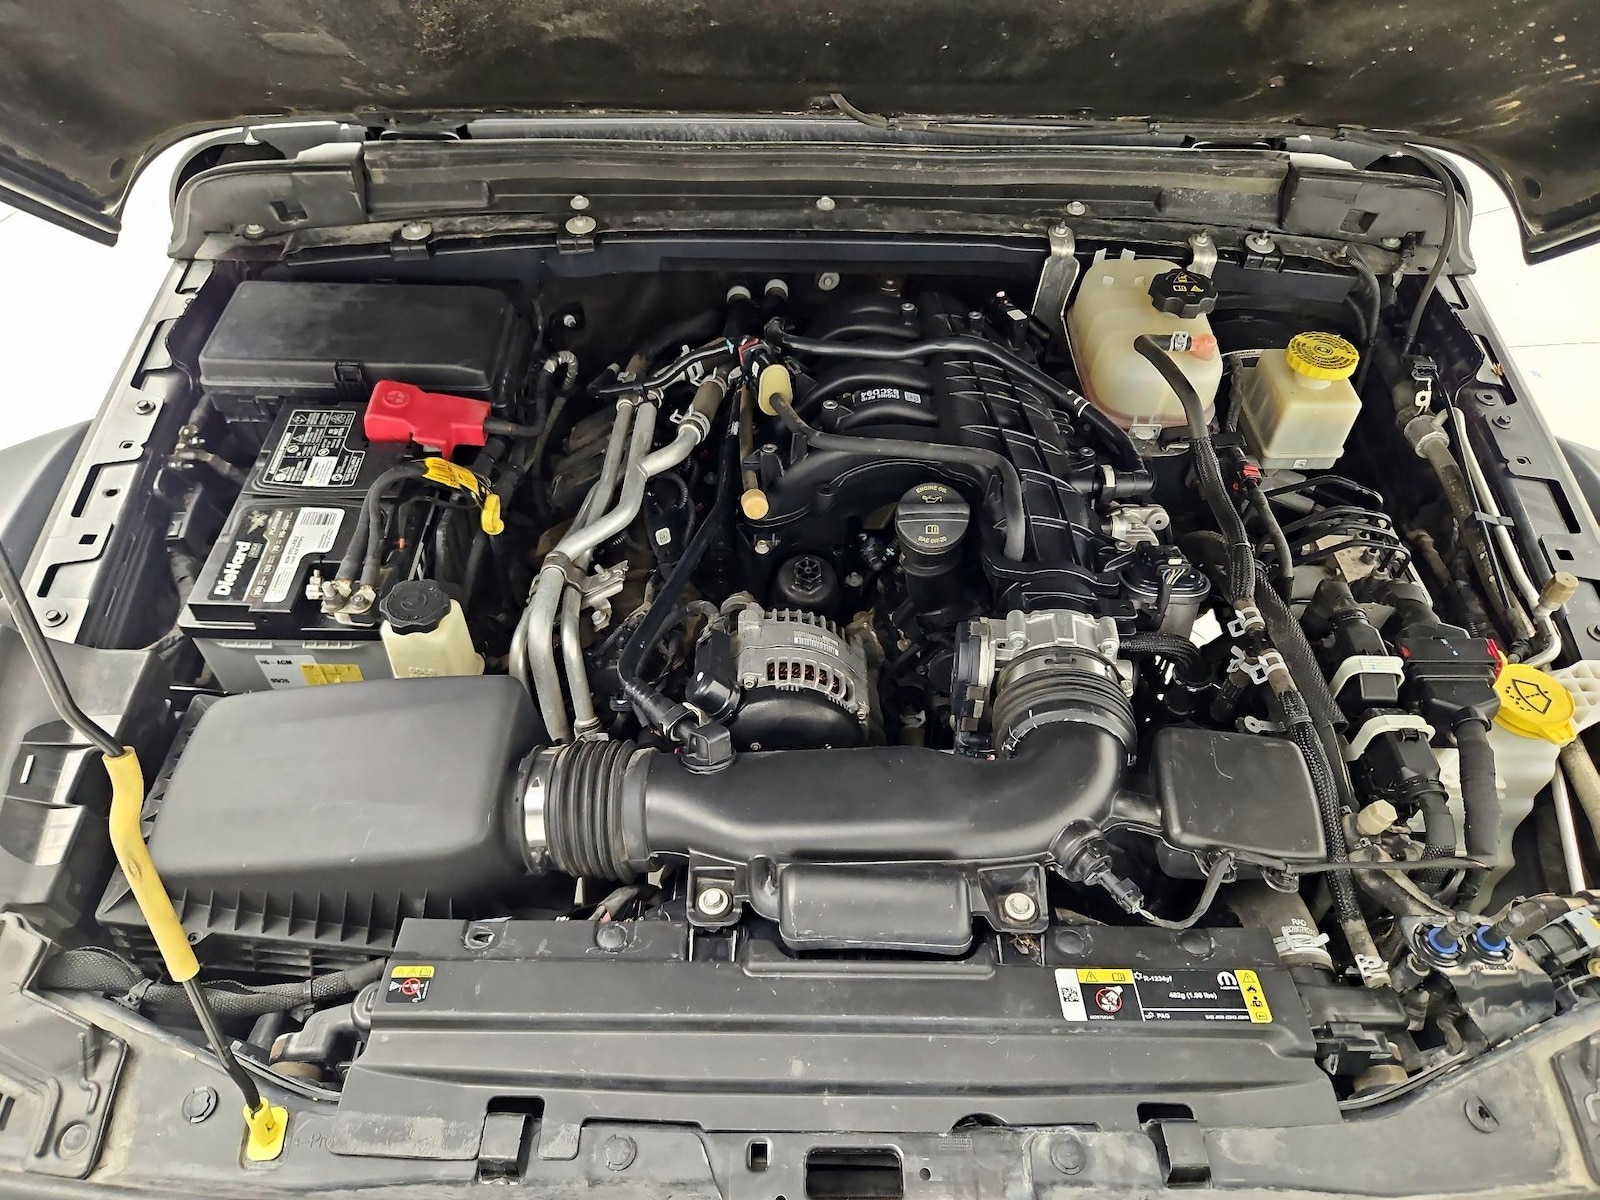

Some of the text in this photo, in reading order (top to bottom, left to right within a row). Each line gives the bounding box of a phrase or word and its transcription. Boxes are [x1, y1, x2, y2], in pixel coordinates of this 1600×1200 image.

[915, 485, 947, 494] ENGINE OIL
[918, 535, 930, 544] SAE
[214, 541, 251, 596] DieHard
